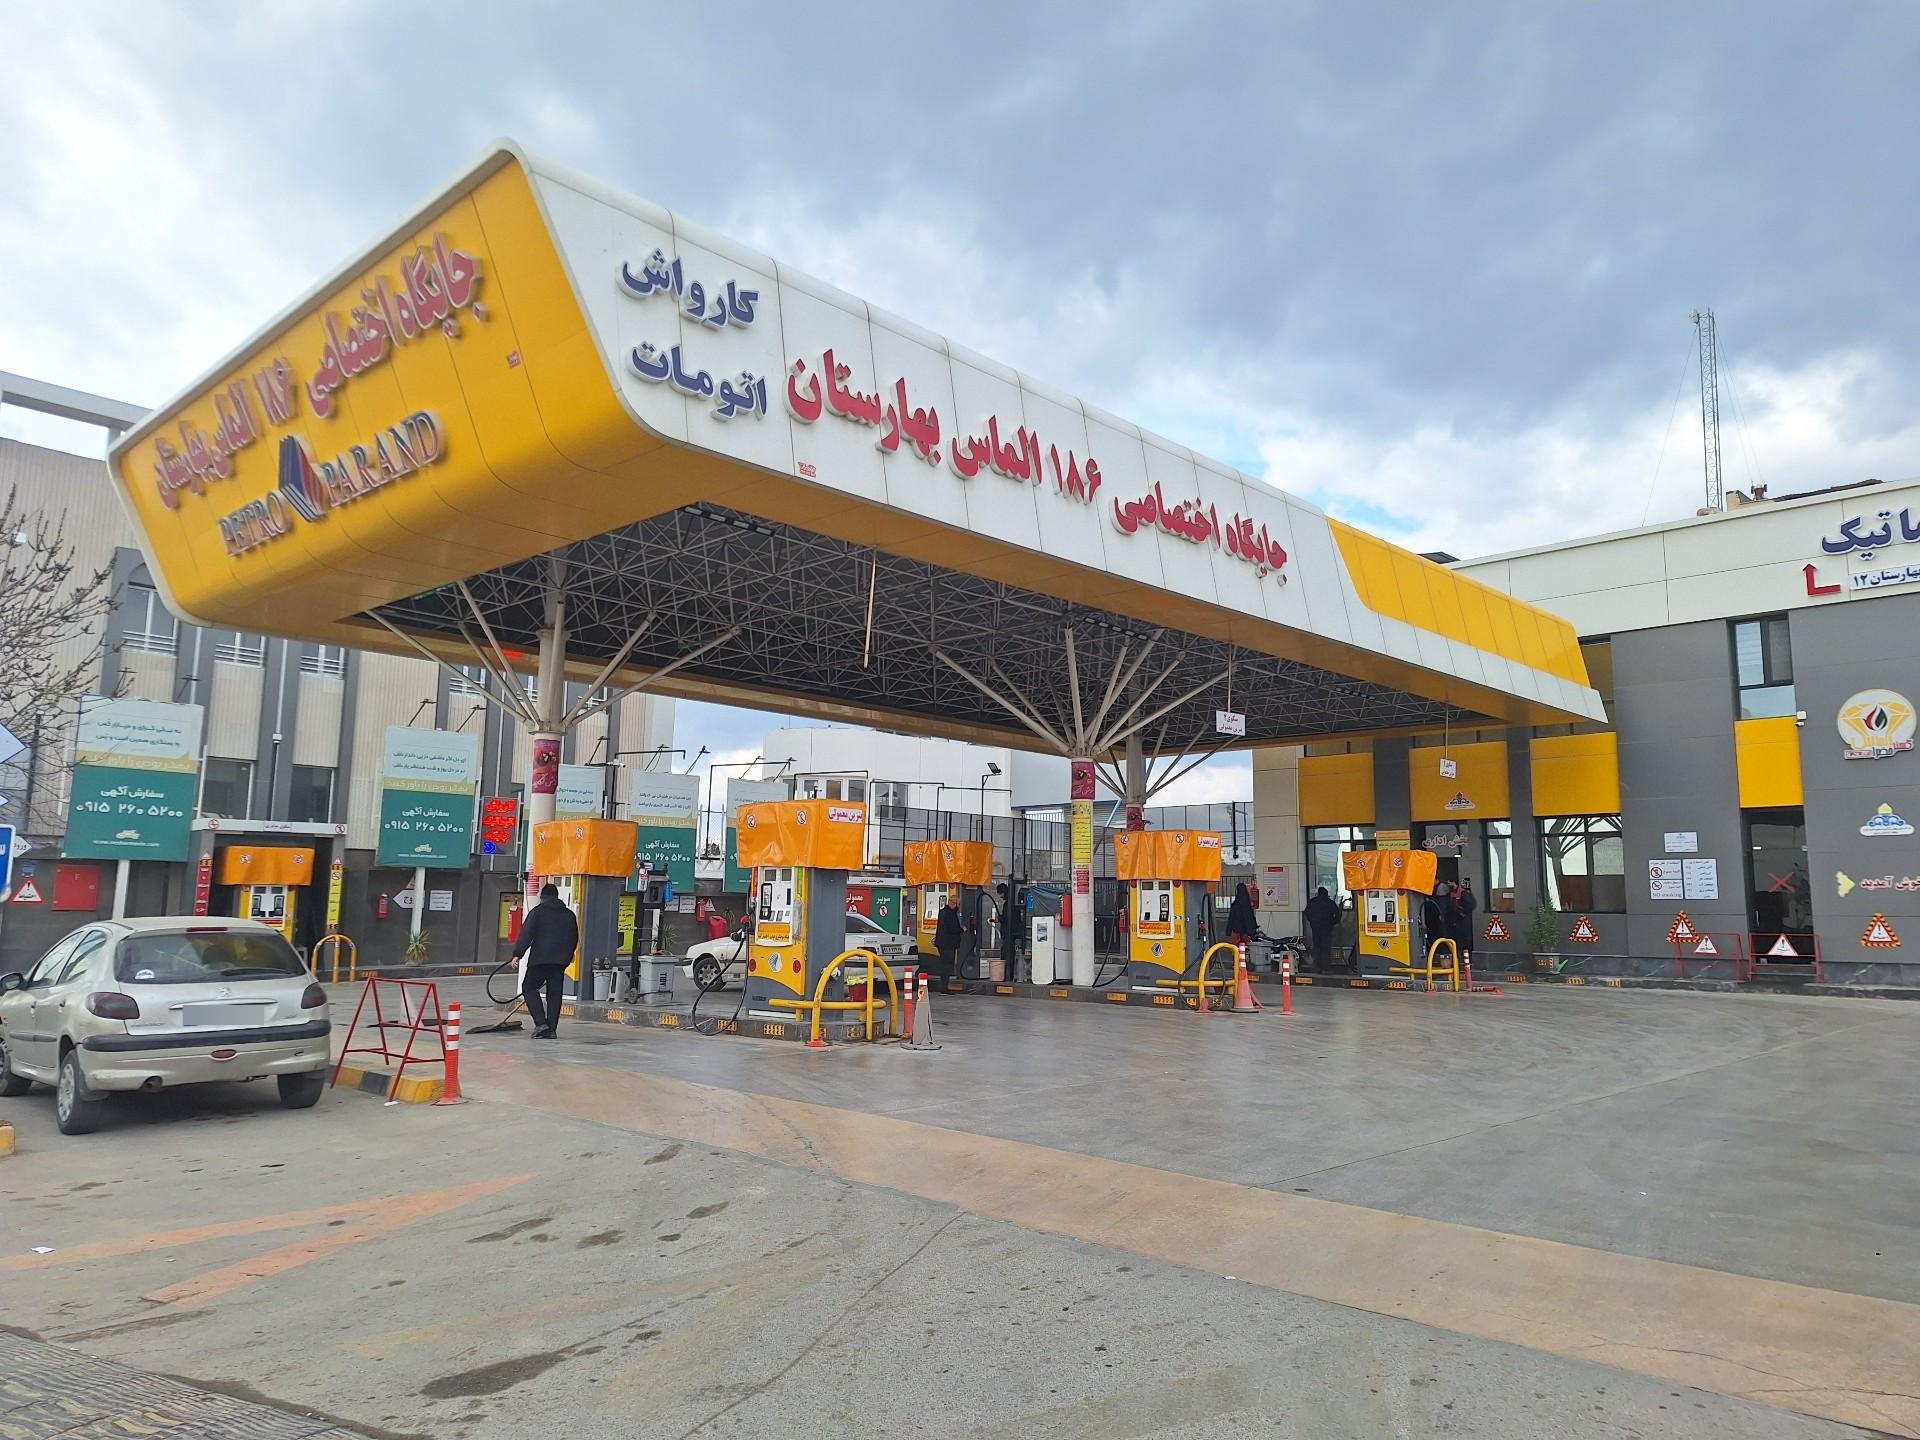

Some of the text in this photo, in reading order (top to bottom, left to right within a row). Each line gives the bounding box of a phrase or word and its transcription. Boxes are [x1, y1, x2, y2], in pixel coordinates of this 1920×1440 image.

[400, 231, 488, 339] جایگاه
[305, 275, 401, 419] اختصاصی
[629, 341, 767, 421] اتومات
[218, 409, 447, 557] PETRO PARAND
[786, 348, 1288, 587] جایگاه اختصاصی ۱۸۶ الماس بهارستان
[1820, 506, 1920, 560] اتیک
[76, 801, 111, 813] ۰۹۱۵
[100, 785, 165, 800] سفارش آگهی
[384, 820, 410, 830] ۰۹۱۵
[402, 806, 449, 818] سفارش آگهی
[645, 839, 680, 849] سفارش آگهی
[1421, 834, 1447, 849] اداری
